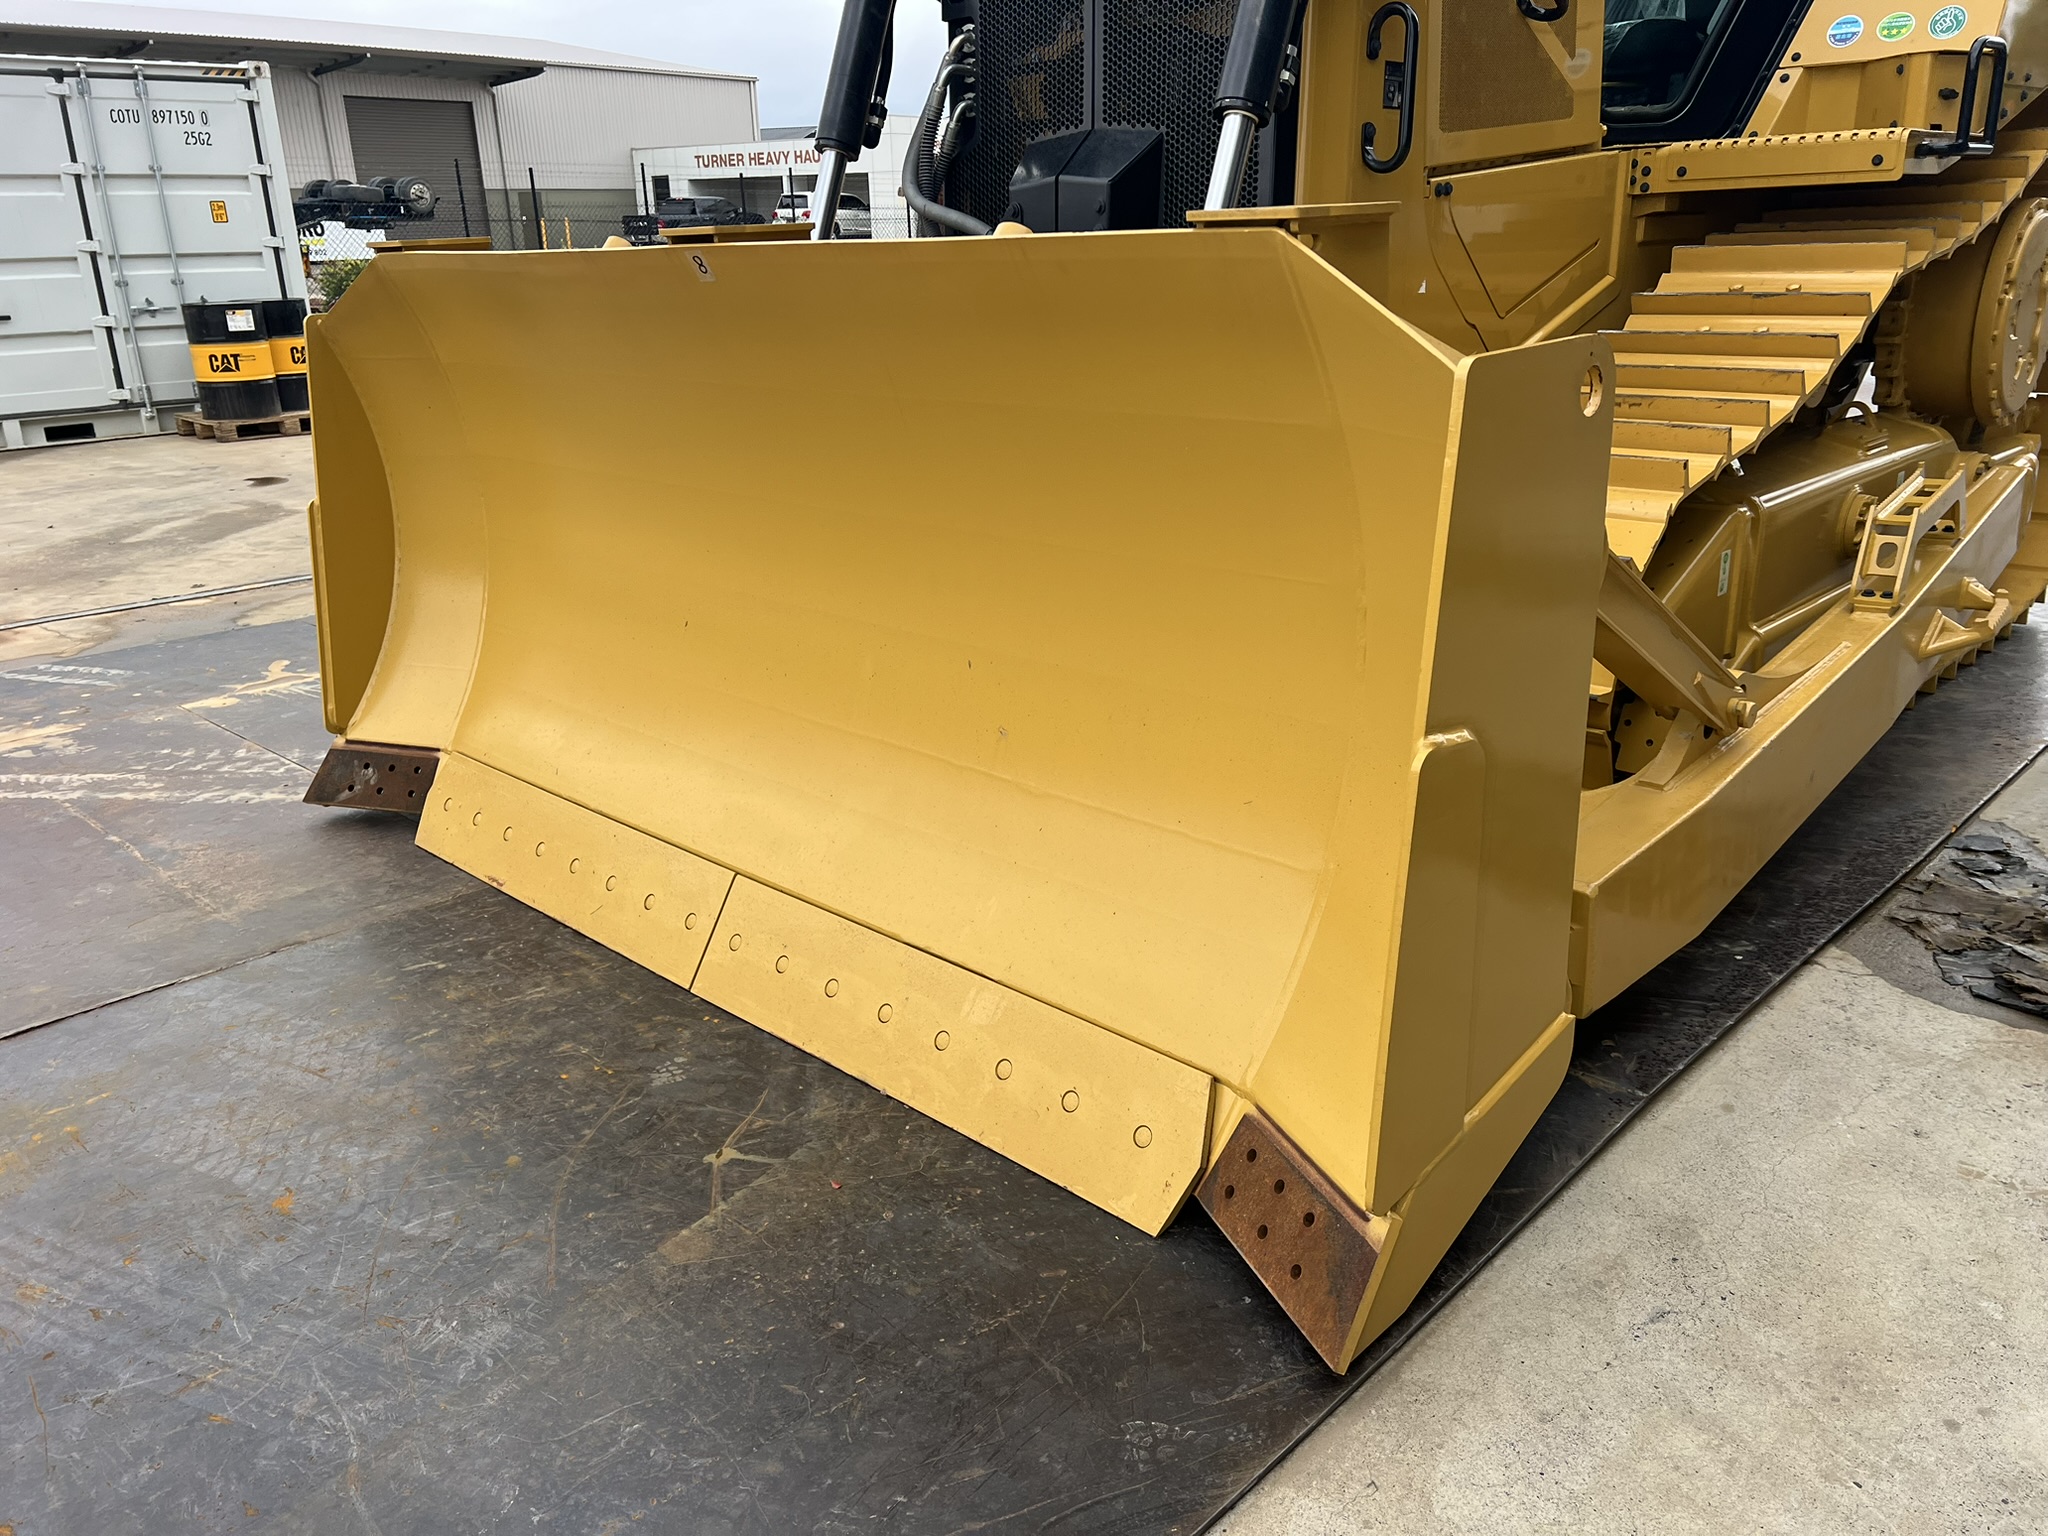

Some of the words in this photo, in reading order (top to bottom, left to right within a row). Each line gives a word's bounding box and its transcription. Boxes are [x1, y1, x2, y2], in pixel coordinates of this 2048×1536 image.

[109, 108, 140, 124] COTU
[151, 109, 195, 125] 897150
[200, 110, 208, 126] 0
[183, 131, 213, 147] 25G2
[694, 153, 745, 169] TURNER
[748, 151, 790, 167] HEAVY
[692, 255, 708, 275] 8
[208, 353, 240, 373] CAT
